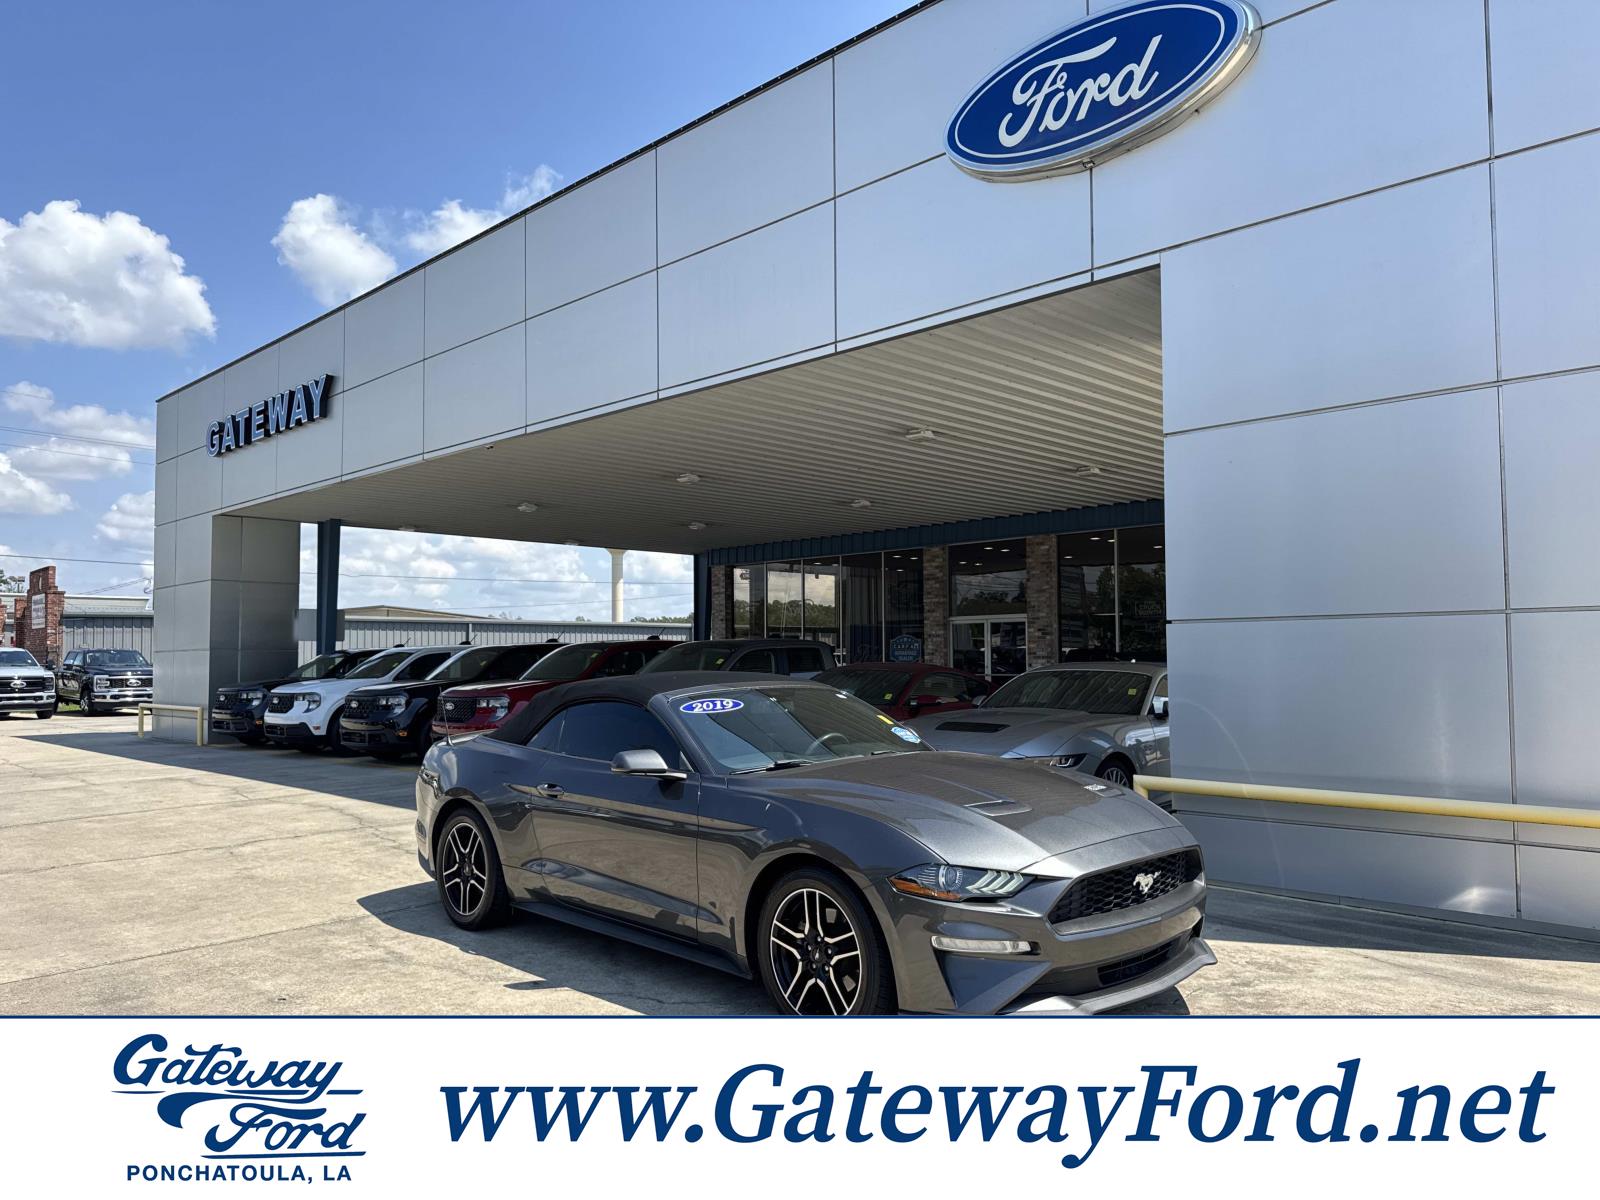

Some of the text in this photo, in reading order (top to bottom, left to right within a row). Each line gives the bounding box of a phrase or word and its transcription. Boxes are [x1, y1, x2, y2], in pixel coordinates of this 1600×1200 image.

[998, 34, 1163, 148] Ford
[205, 374, 330, 457] GATEWAY
[692, 700, 734, 713] 2019
